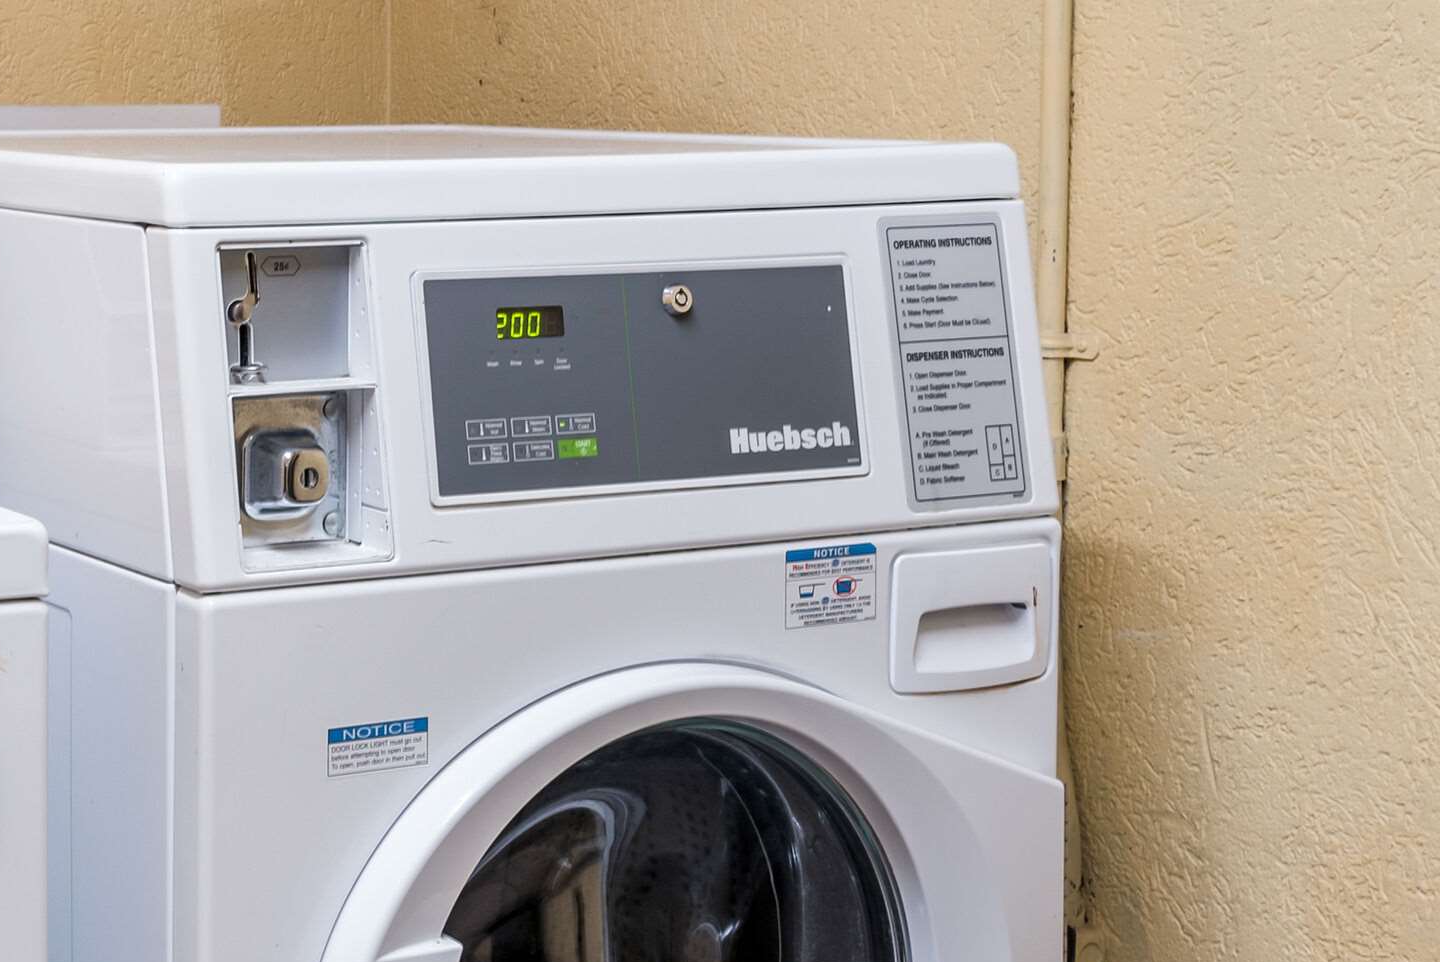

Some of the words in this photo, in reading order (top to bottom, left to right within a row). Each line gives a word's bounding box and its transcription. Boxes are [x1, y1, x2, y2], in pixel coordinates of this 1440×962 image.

[893, 239, 936, 249] OPERATING
[938, 236, 992, 247] INSTRUCTIONS
[906, 351, 949, 362] DISPENSER
[951, 347, 1004, 359] INSTRUCTIONS
[730, 422, 850, 454] Huebsch
[814, 546, 849, 558] NOTICE
[343, 721, 415, 740] NOTICE
[332, 744, 350, 753] DOOR
